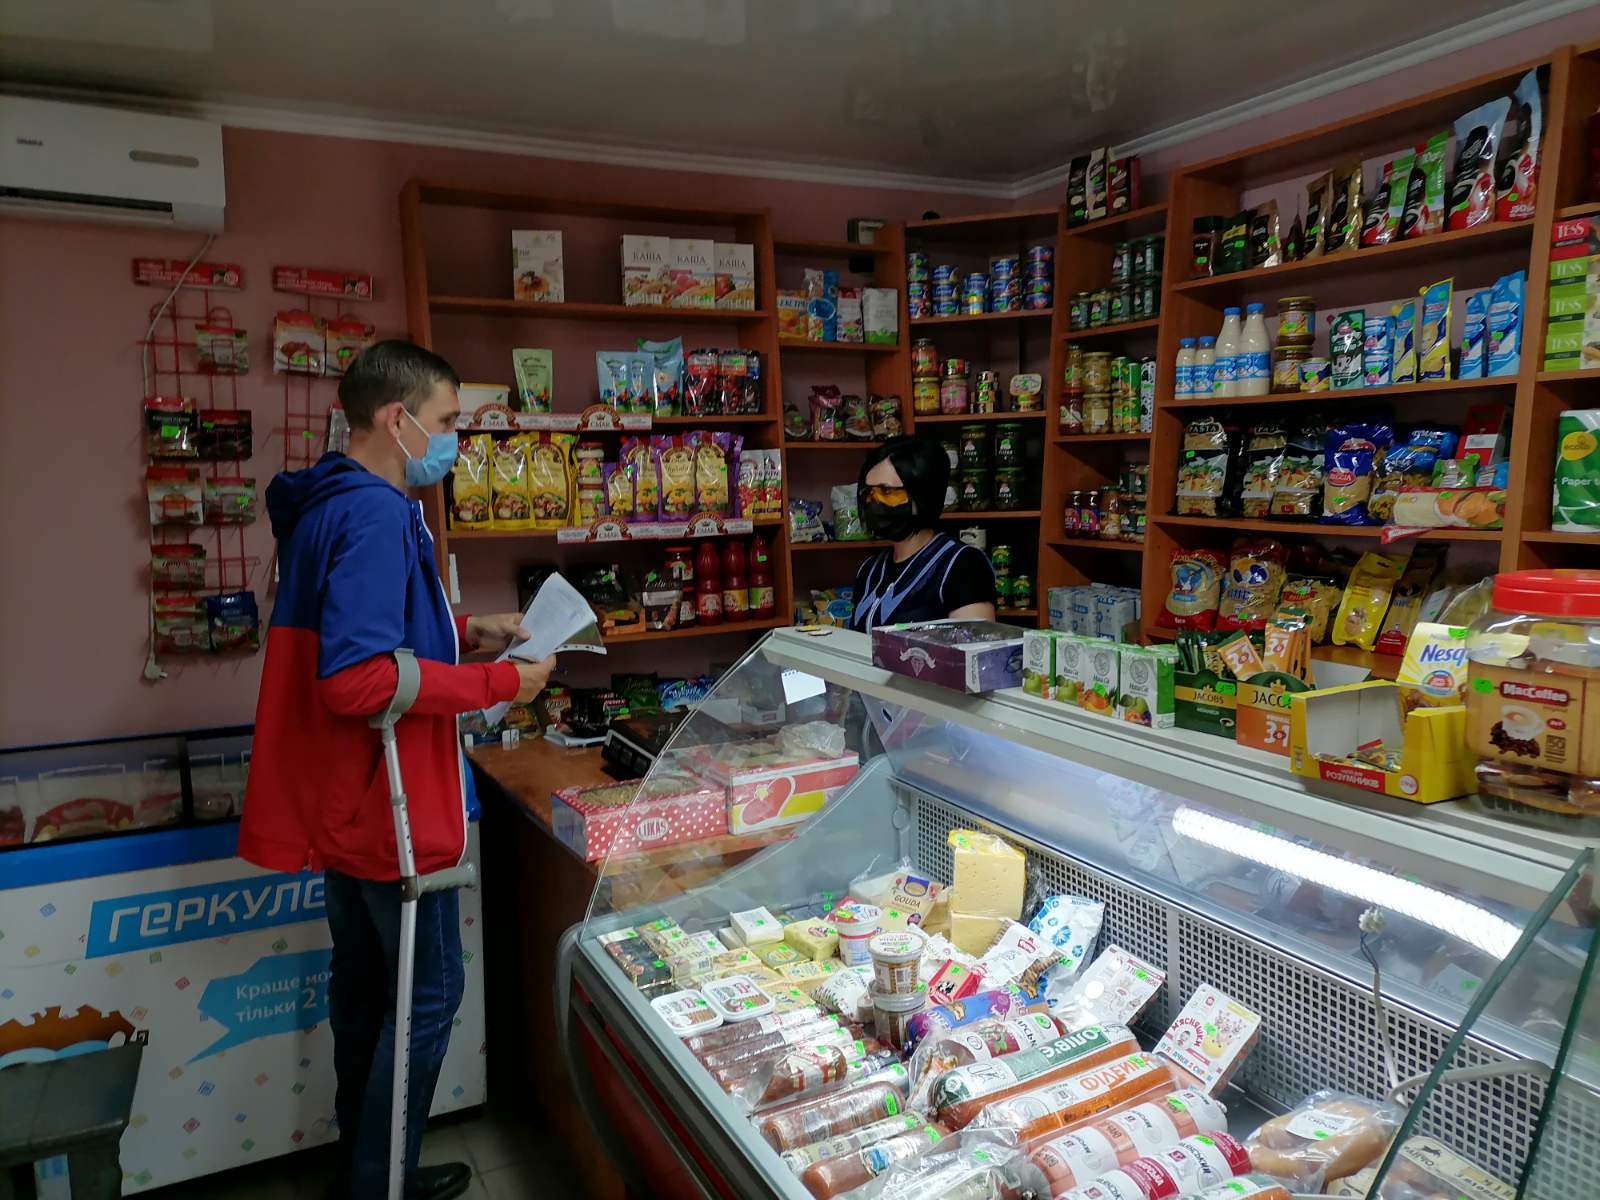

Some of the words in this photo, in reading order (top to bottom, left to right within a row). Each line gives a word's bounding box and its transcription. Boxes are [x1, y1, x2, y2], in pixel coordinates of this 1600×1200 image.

[633, 252, 662, 263] КАША
[677, 255, 705, 266] КАША
[719, 259, 746, 269] КАША
[1561, 476, 1593, 490] Paper
[1193, 690, 1224, 705] JACOBS
[1503, 682, 1569, 703] MacCoffee
[894, 894, 921, 908] GOUDA
[235, 978, 300, 1001] Краще
[305, 971, 334, 986] мо
[236, 1000, 297, 1024] тільки
[303, 989, 318, 1009] 2
[1172, 1017, 1203, 1047] М'ЯСНЯШКИ
